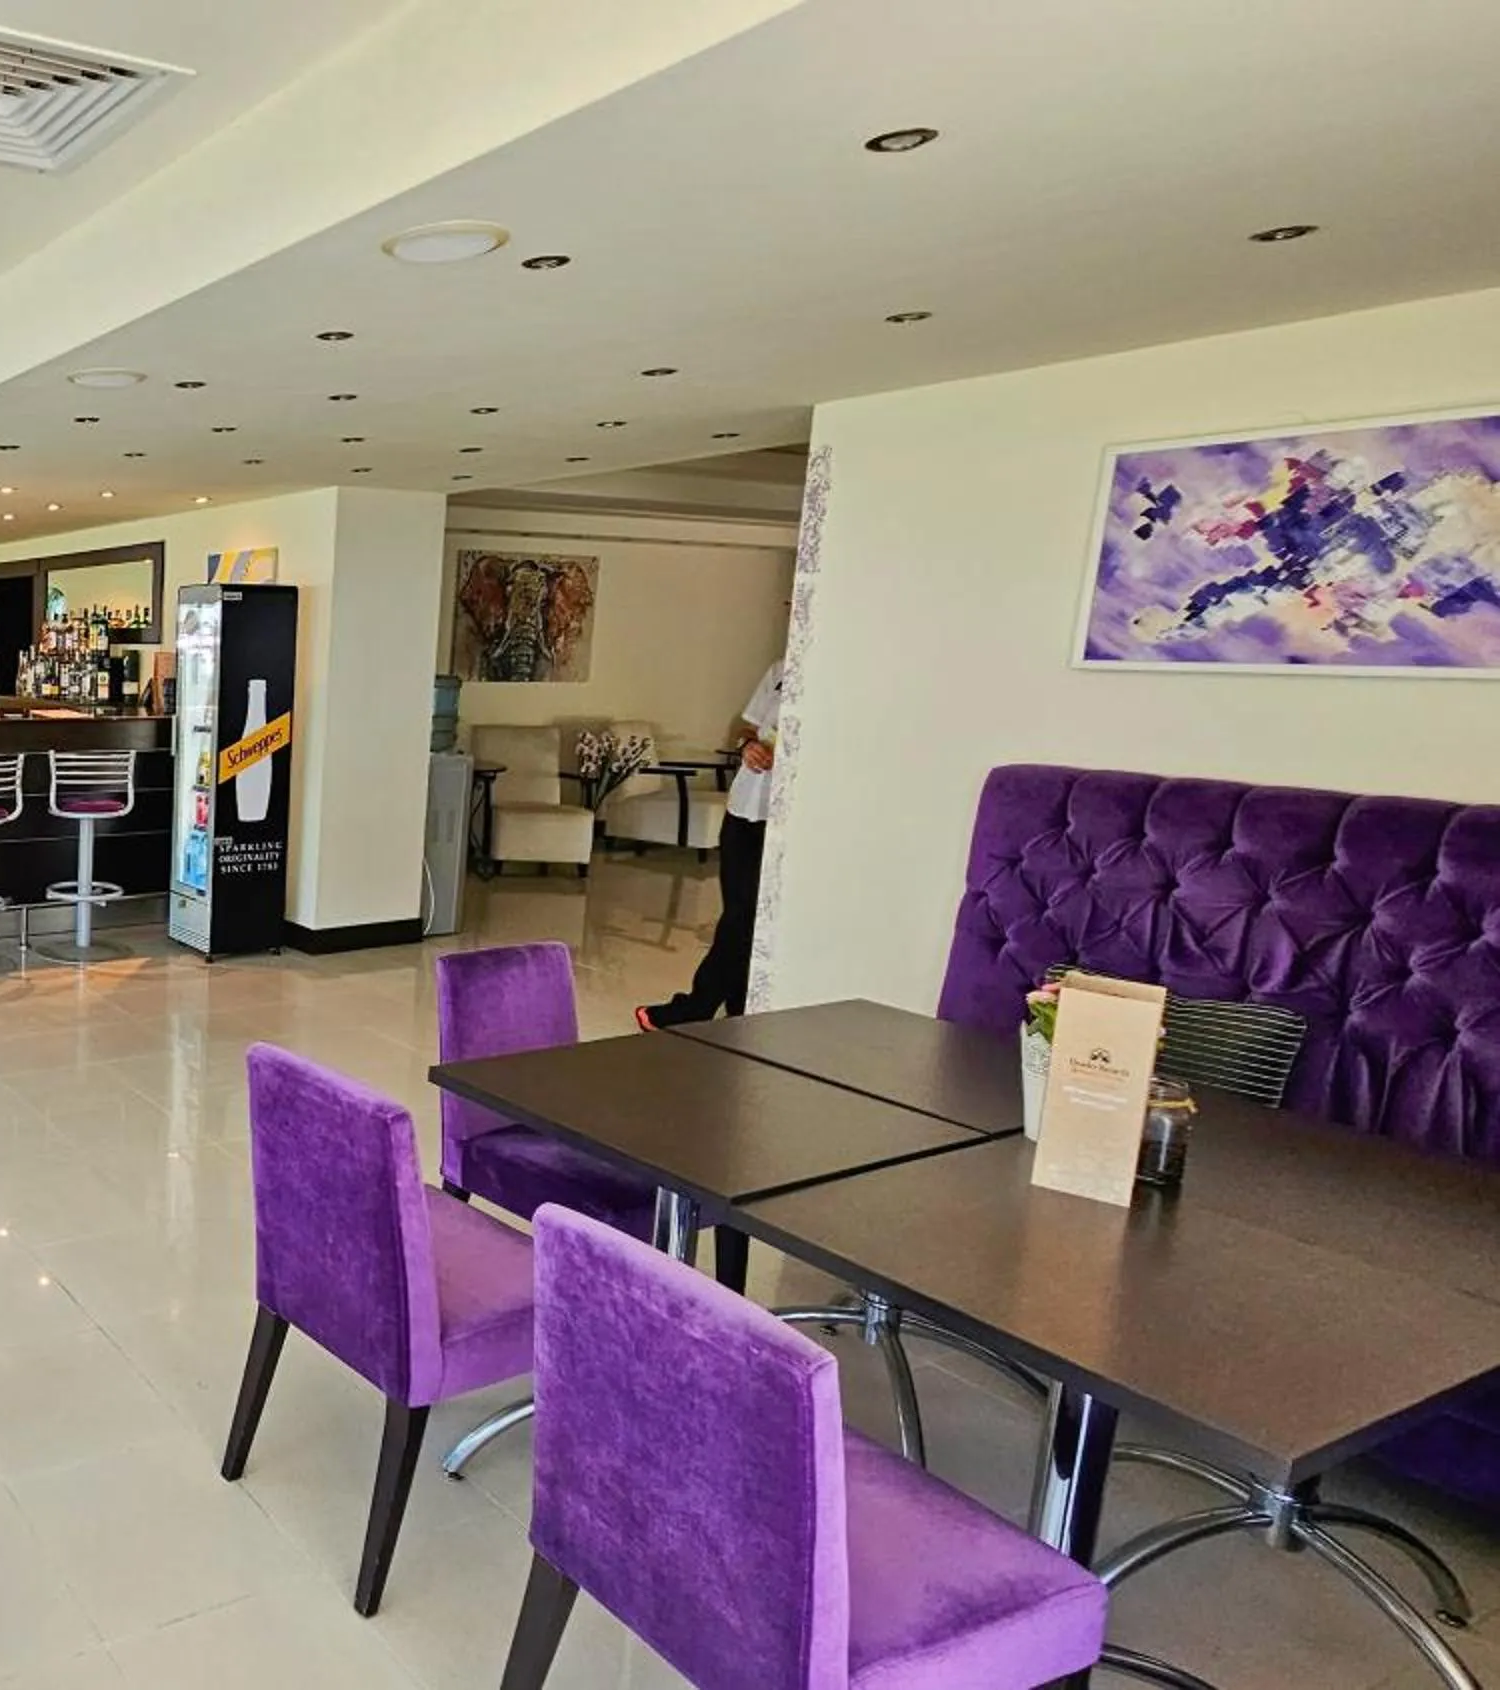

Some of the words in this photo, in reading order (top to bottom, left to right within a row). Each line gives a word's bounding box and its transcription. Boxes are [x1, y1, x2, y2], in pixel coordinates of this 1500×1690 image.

[228, 728, 283, 768] Schweppes
[219, 842, 283, 853] SPARKLING
[218, 853, 280, 863] ORIGINALITY
[220, 863, 252, 875] SINCE
